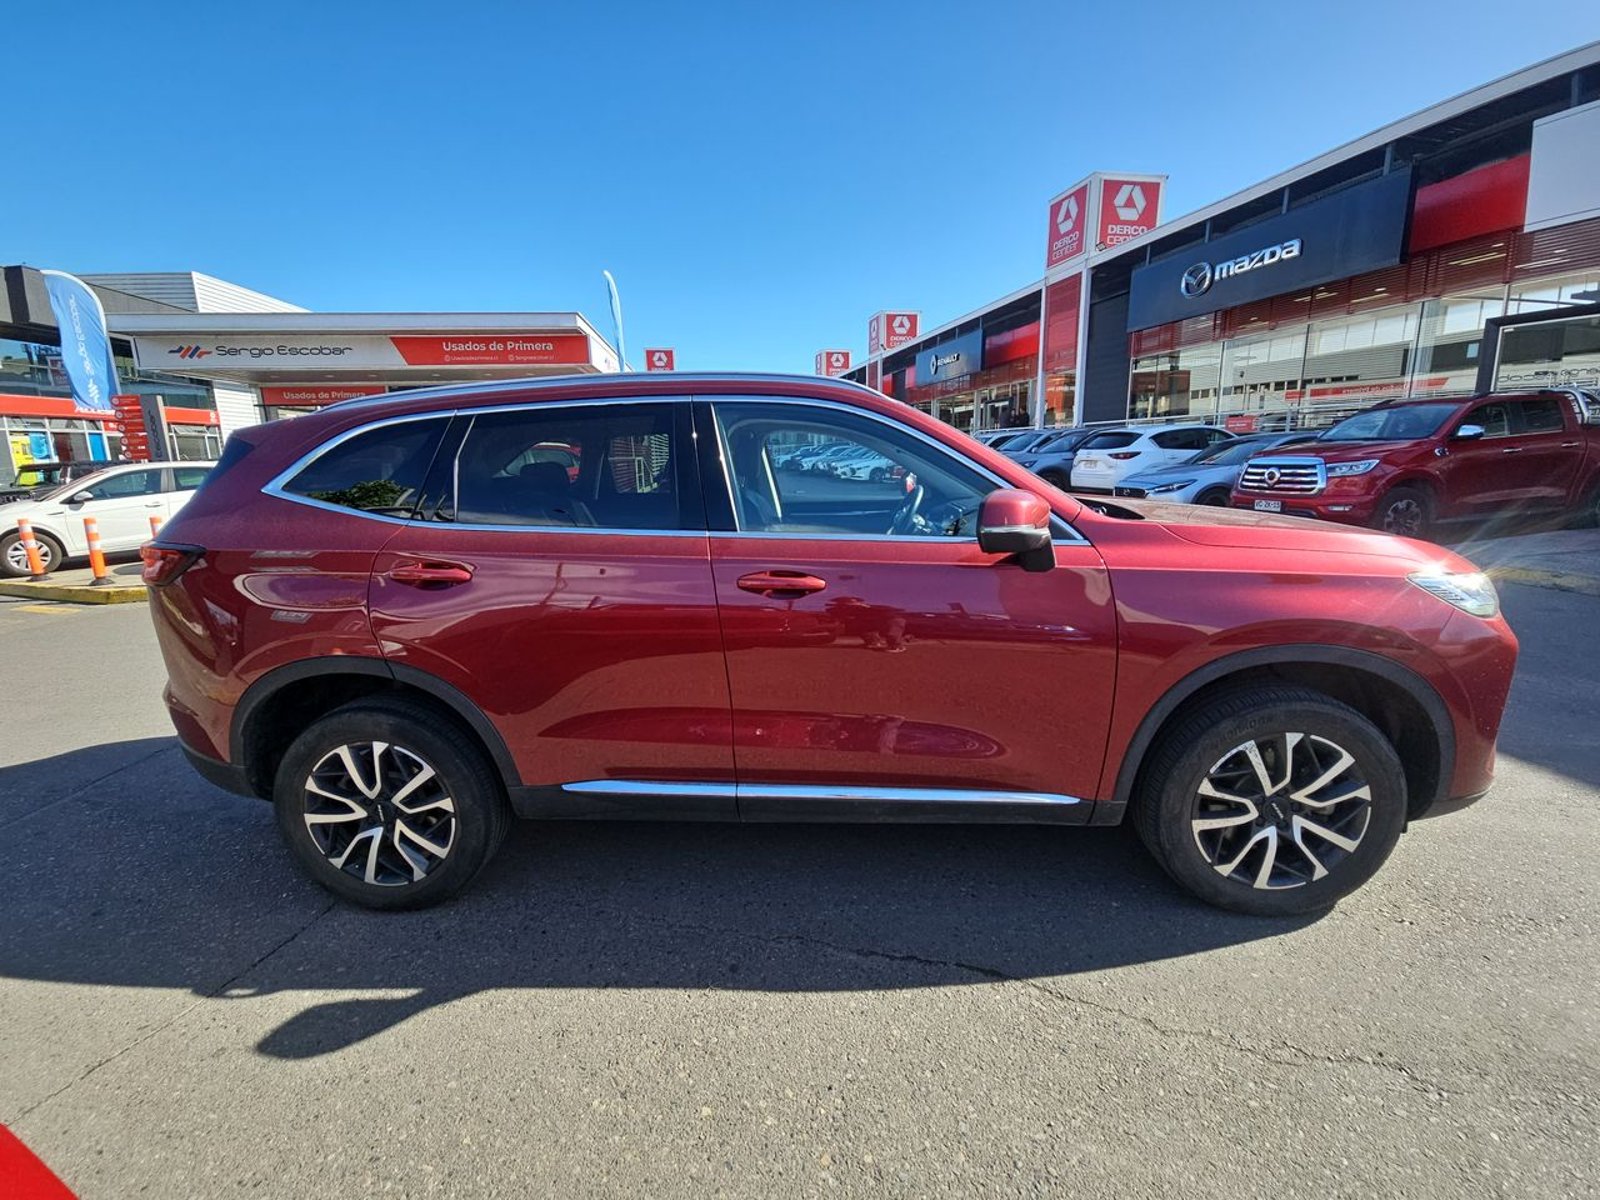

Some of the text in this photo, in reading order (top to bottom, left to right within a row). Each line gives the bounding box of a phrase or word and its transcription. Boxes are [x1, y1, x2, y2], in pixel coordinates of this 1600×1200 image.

[1106, 224, 1147, 236] DERCO
[1053, 230, 1080, 251] DERCO
[442, 340, 553, 351] Usados de Primera
[215, 345, 353, 359] Sergio Escobar
[283, 391, 316, 399] Usados
[318, 391, 329, 399] de
